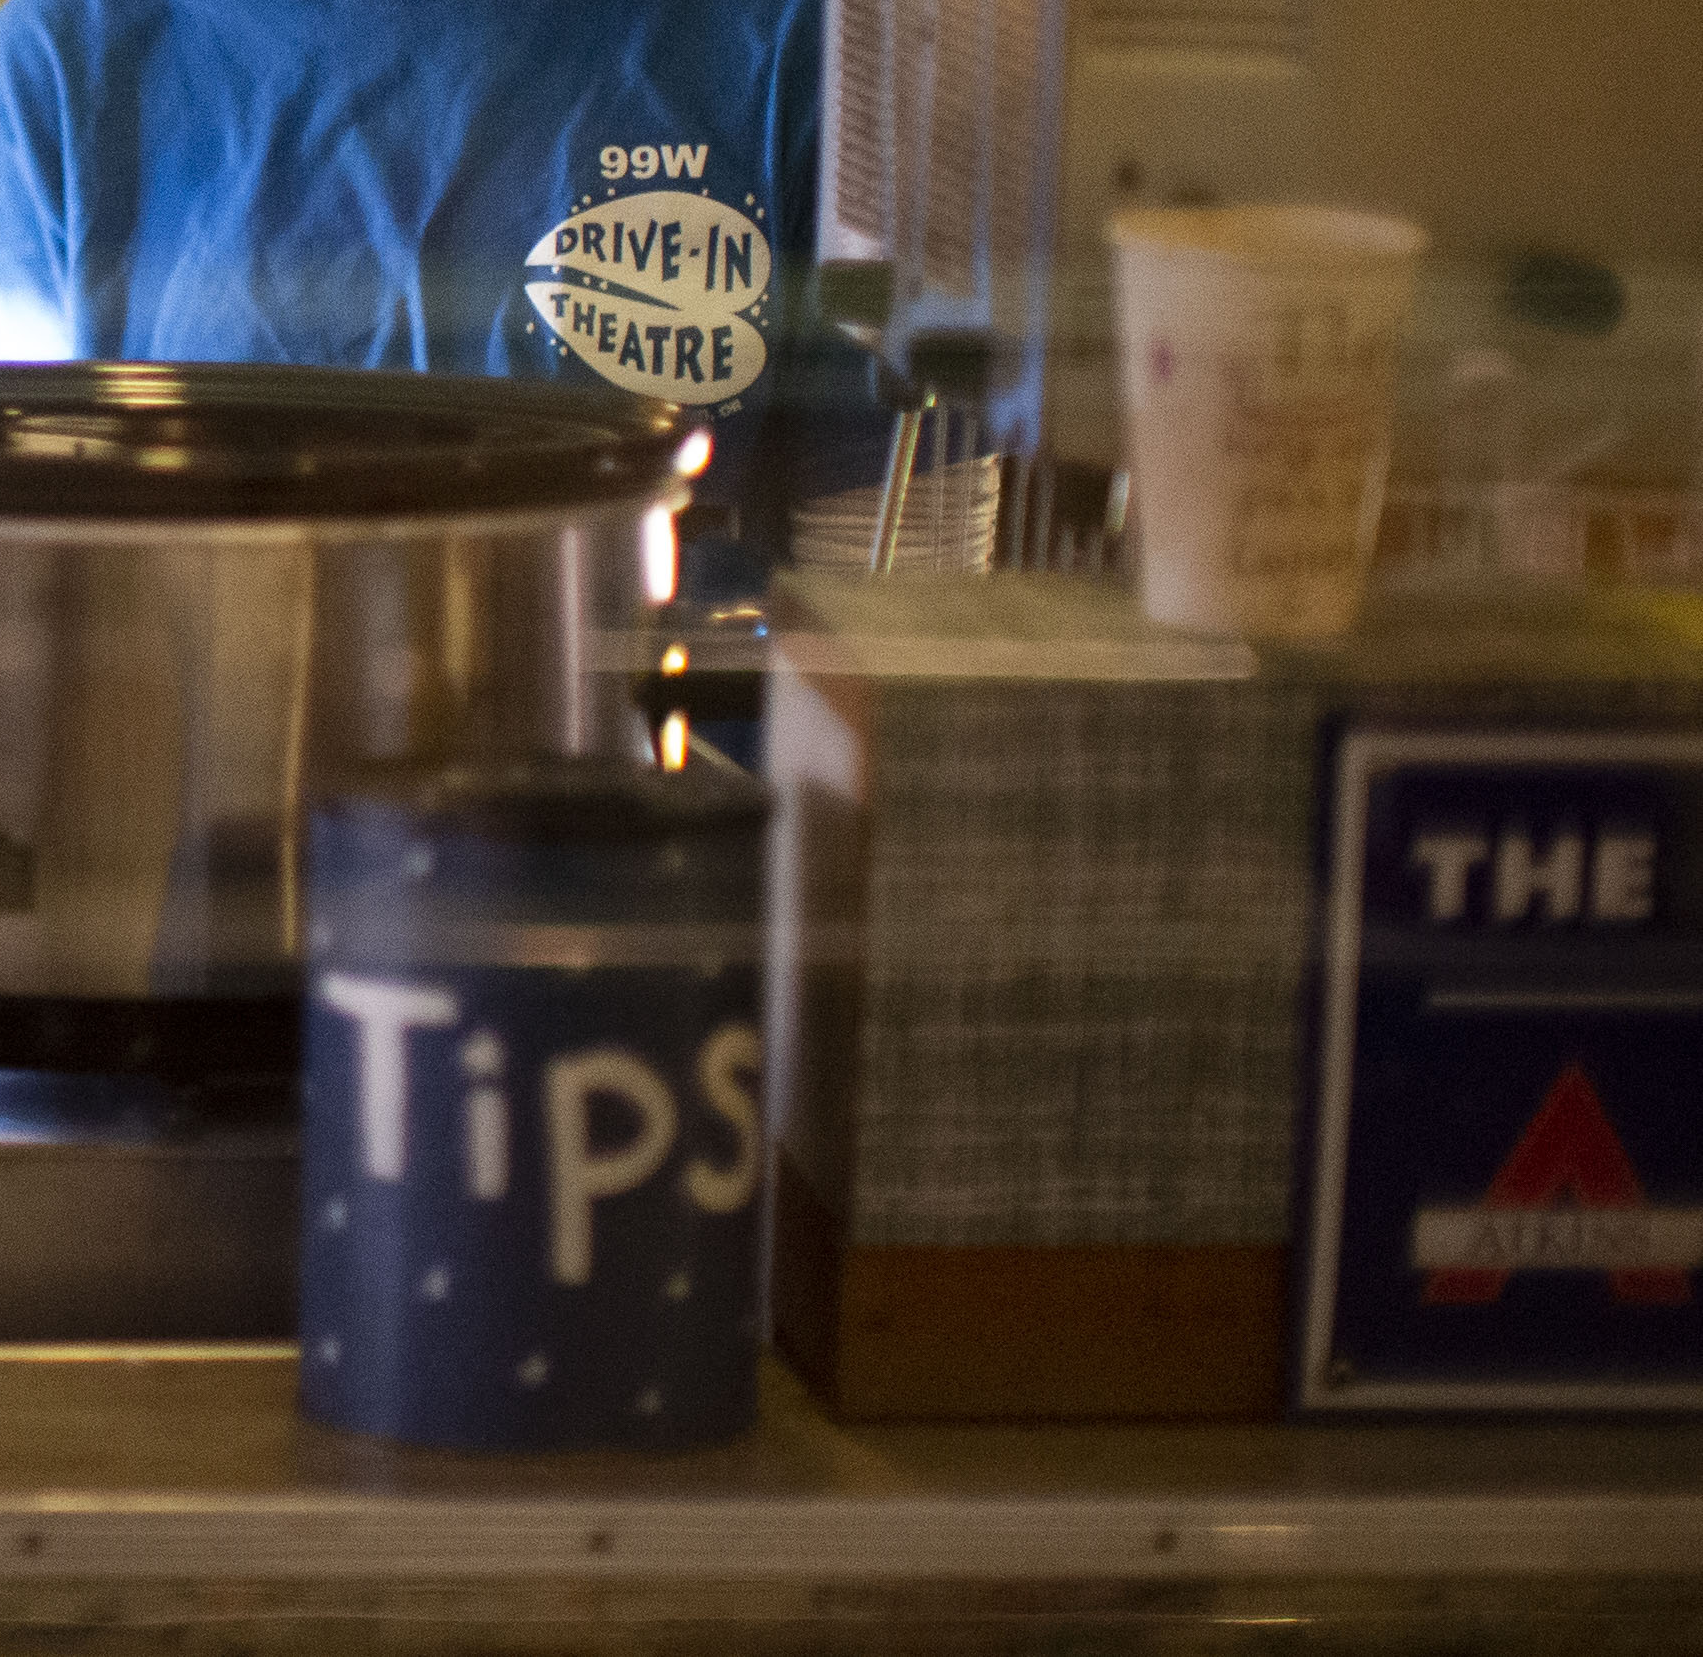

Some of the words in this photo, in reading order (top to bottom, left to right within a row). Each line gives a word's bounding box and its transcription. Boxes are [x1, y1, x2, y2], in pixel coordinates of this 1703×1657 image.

[599, 144, 709, 180] 99W
[554, 218, 753, 294] DRIVE-IN
[548, 292, 734, 386] THEATRE
[1407, 829, 1658, 923] THE
